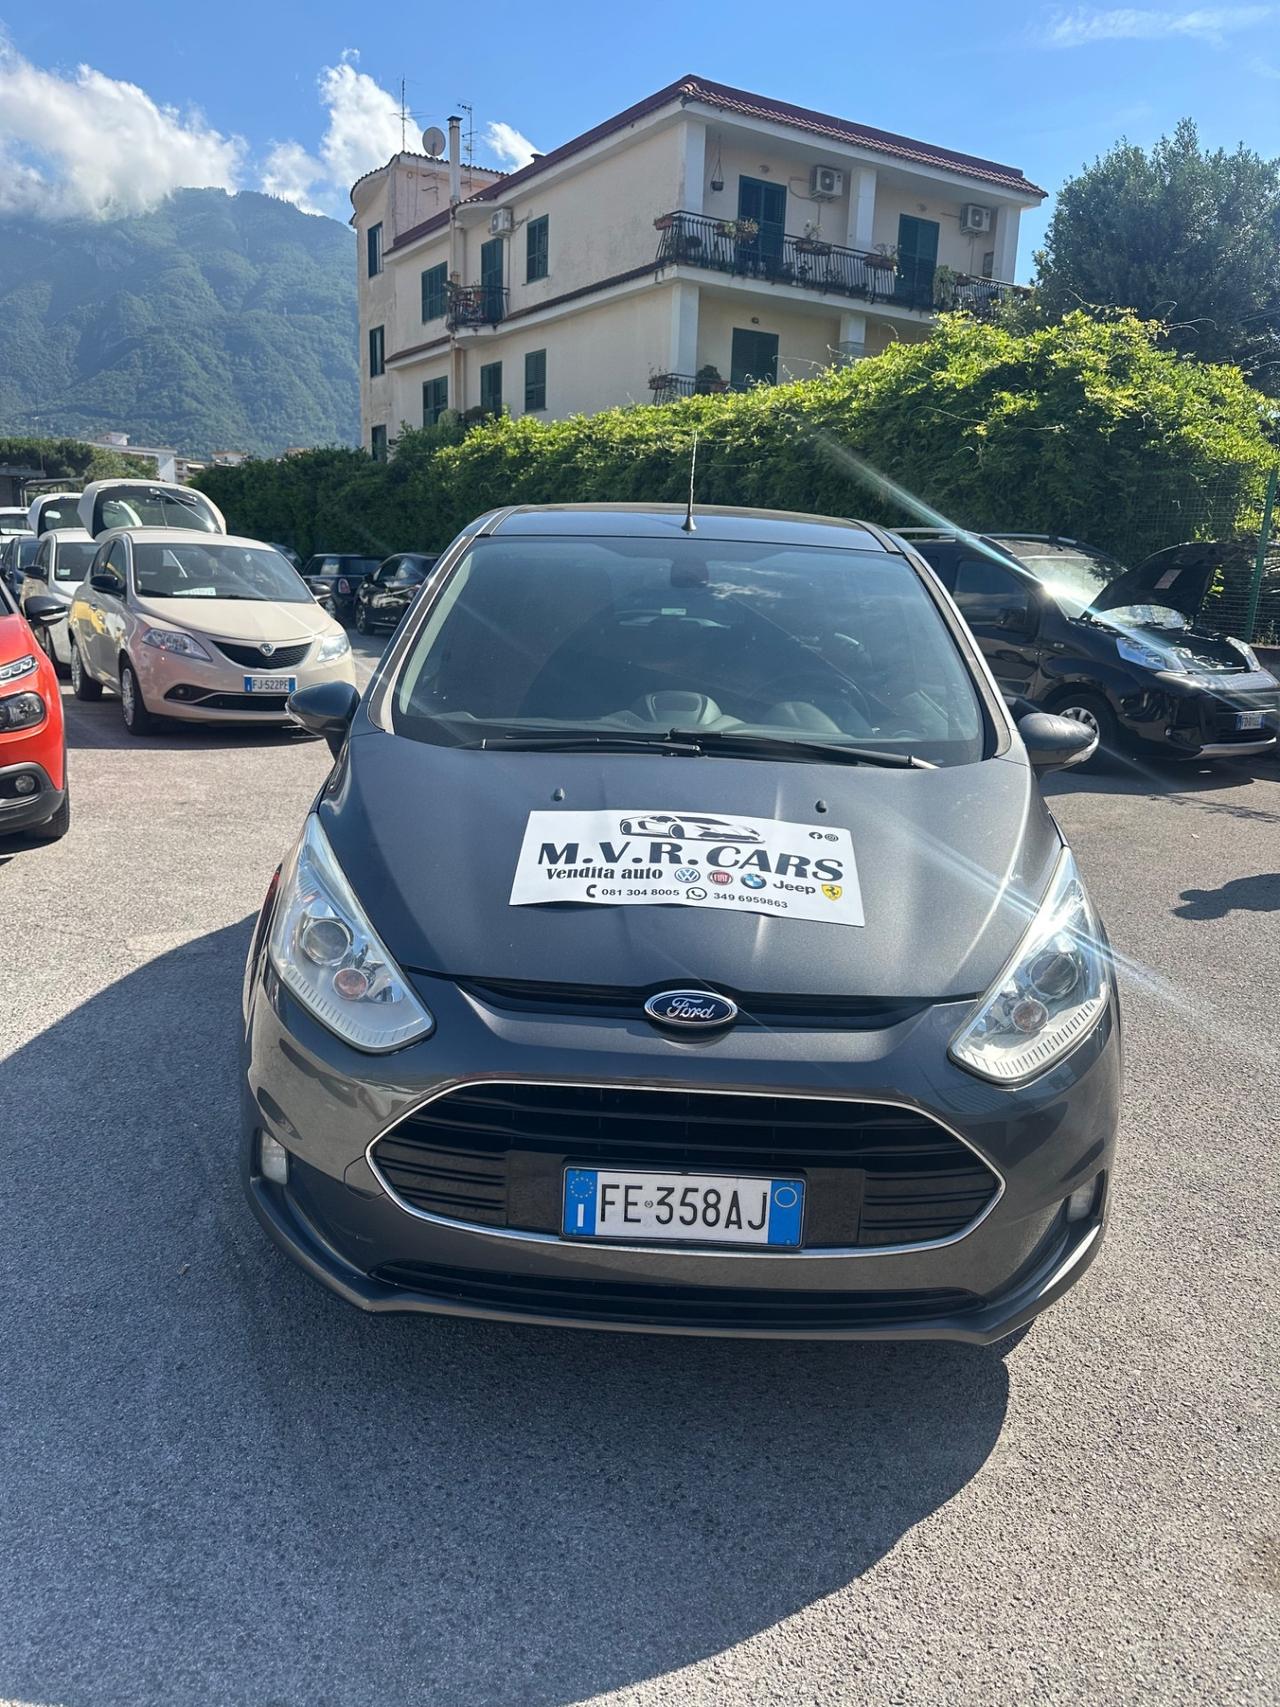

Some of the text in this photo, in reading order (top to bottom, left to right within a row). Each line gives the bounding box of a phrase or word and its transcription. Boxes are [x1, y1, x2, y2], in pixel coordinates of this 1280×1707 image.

[621, 867, 663, 880] auto
[601, 888, 622, 896] 081
[627, 888, 647, 896] 304
[773, 880, 816, 895] Jeep
[713, 892, 788, 909] 349 6959863
[666, 997, 716, 1019] Ford
